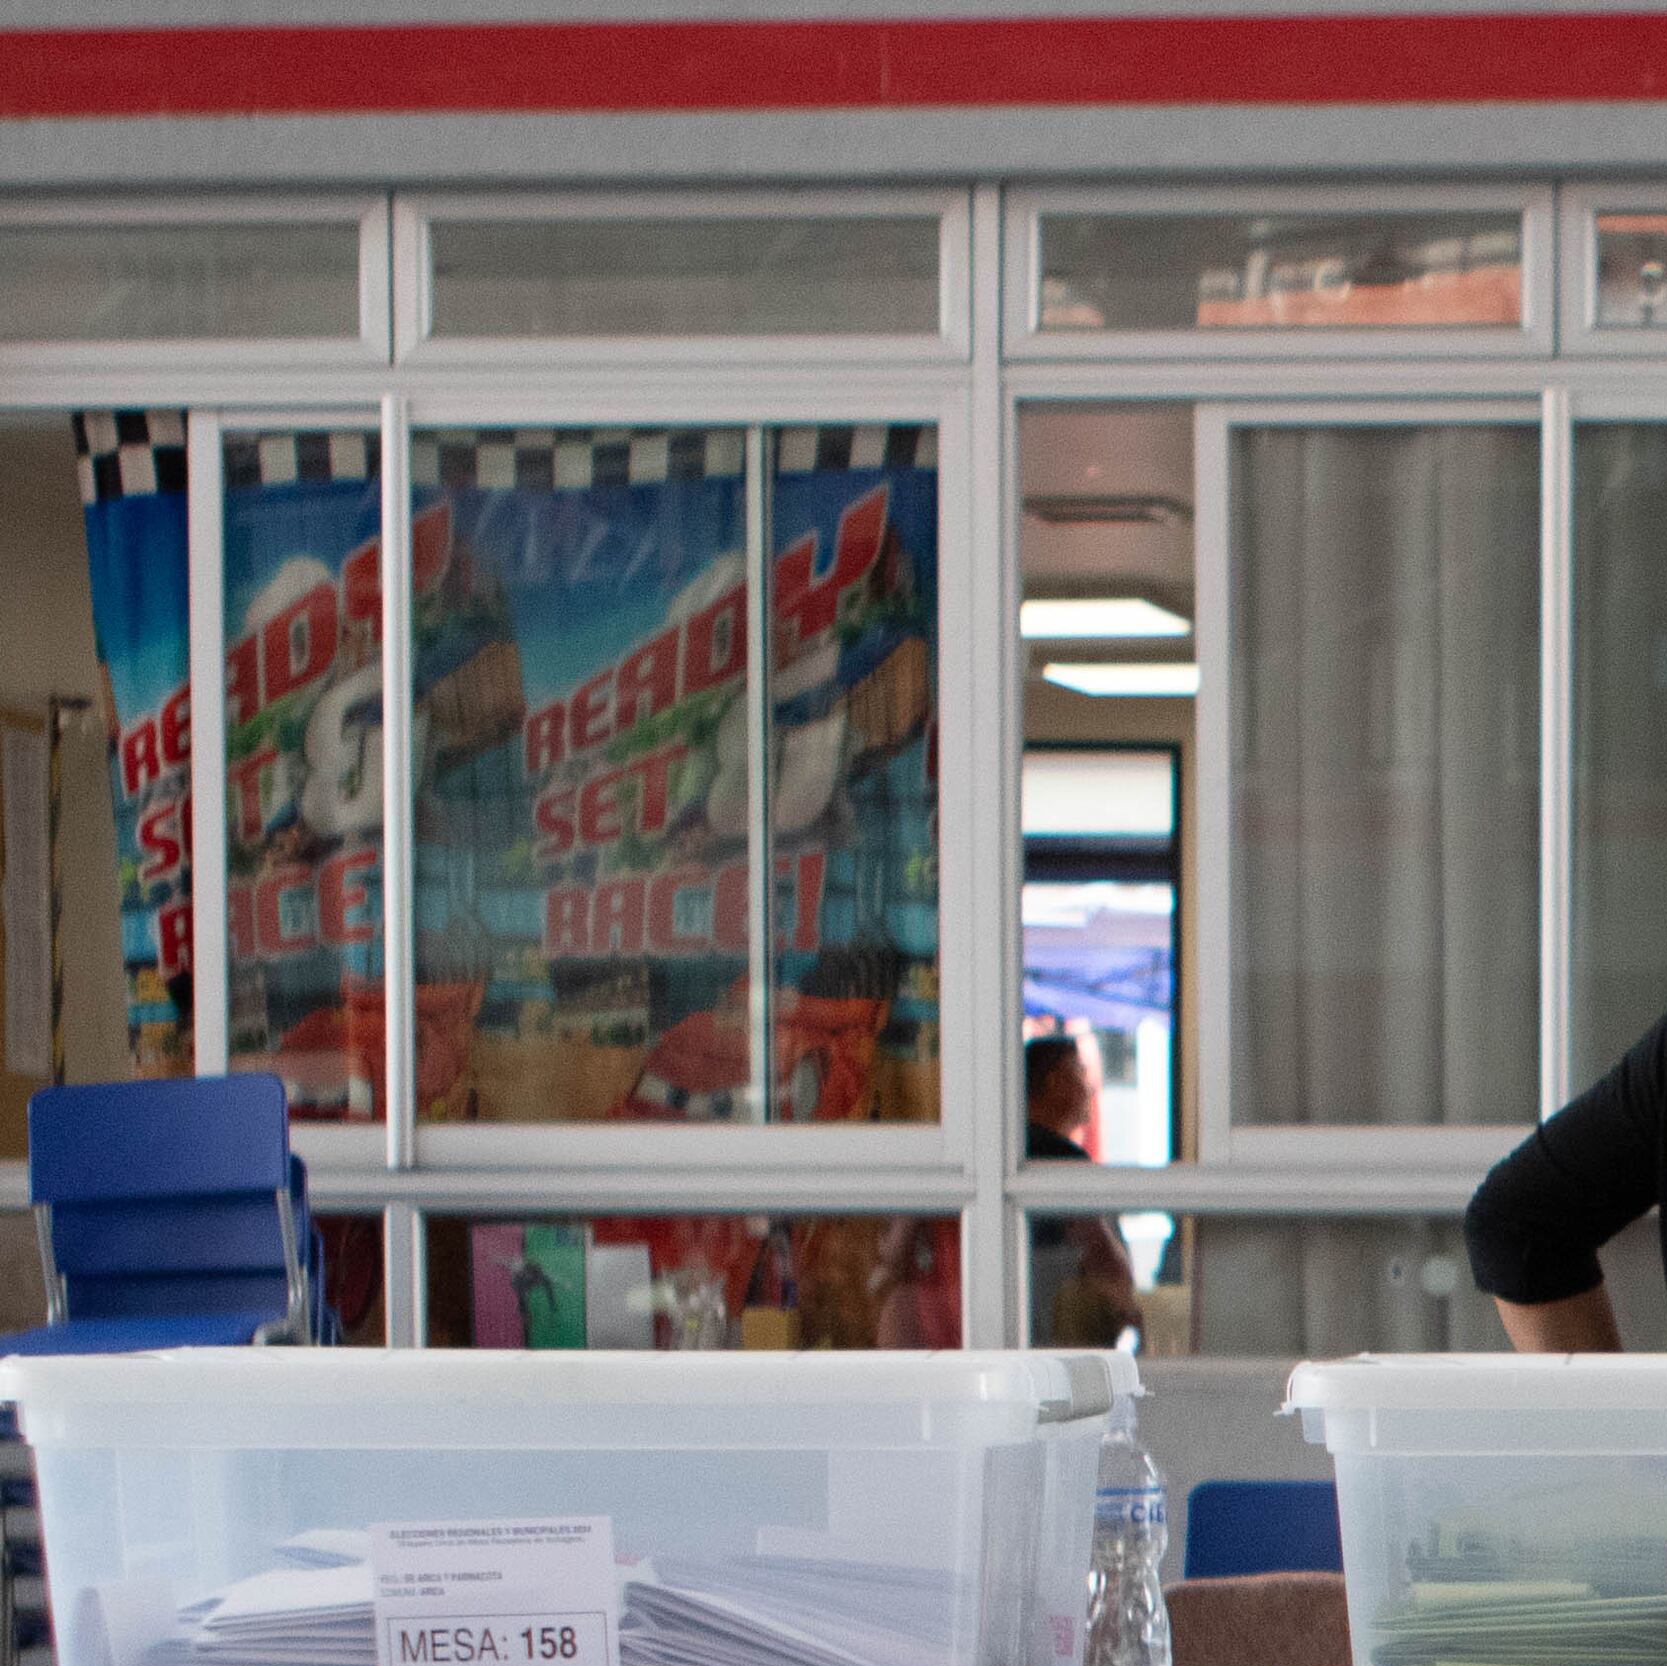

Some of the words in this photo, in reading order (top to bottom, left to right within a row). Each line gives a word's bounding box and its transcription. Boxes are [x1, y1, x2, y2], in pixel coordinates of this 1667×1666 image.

[535, 743, 690, 856] SET
[400, 1628, 509, 1663] MESA:
[520, 1626, 578, 1661] 158
